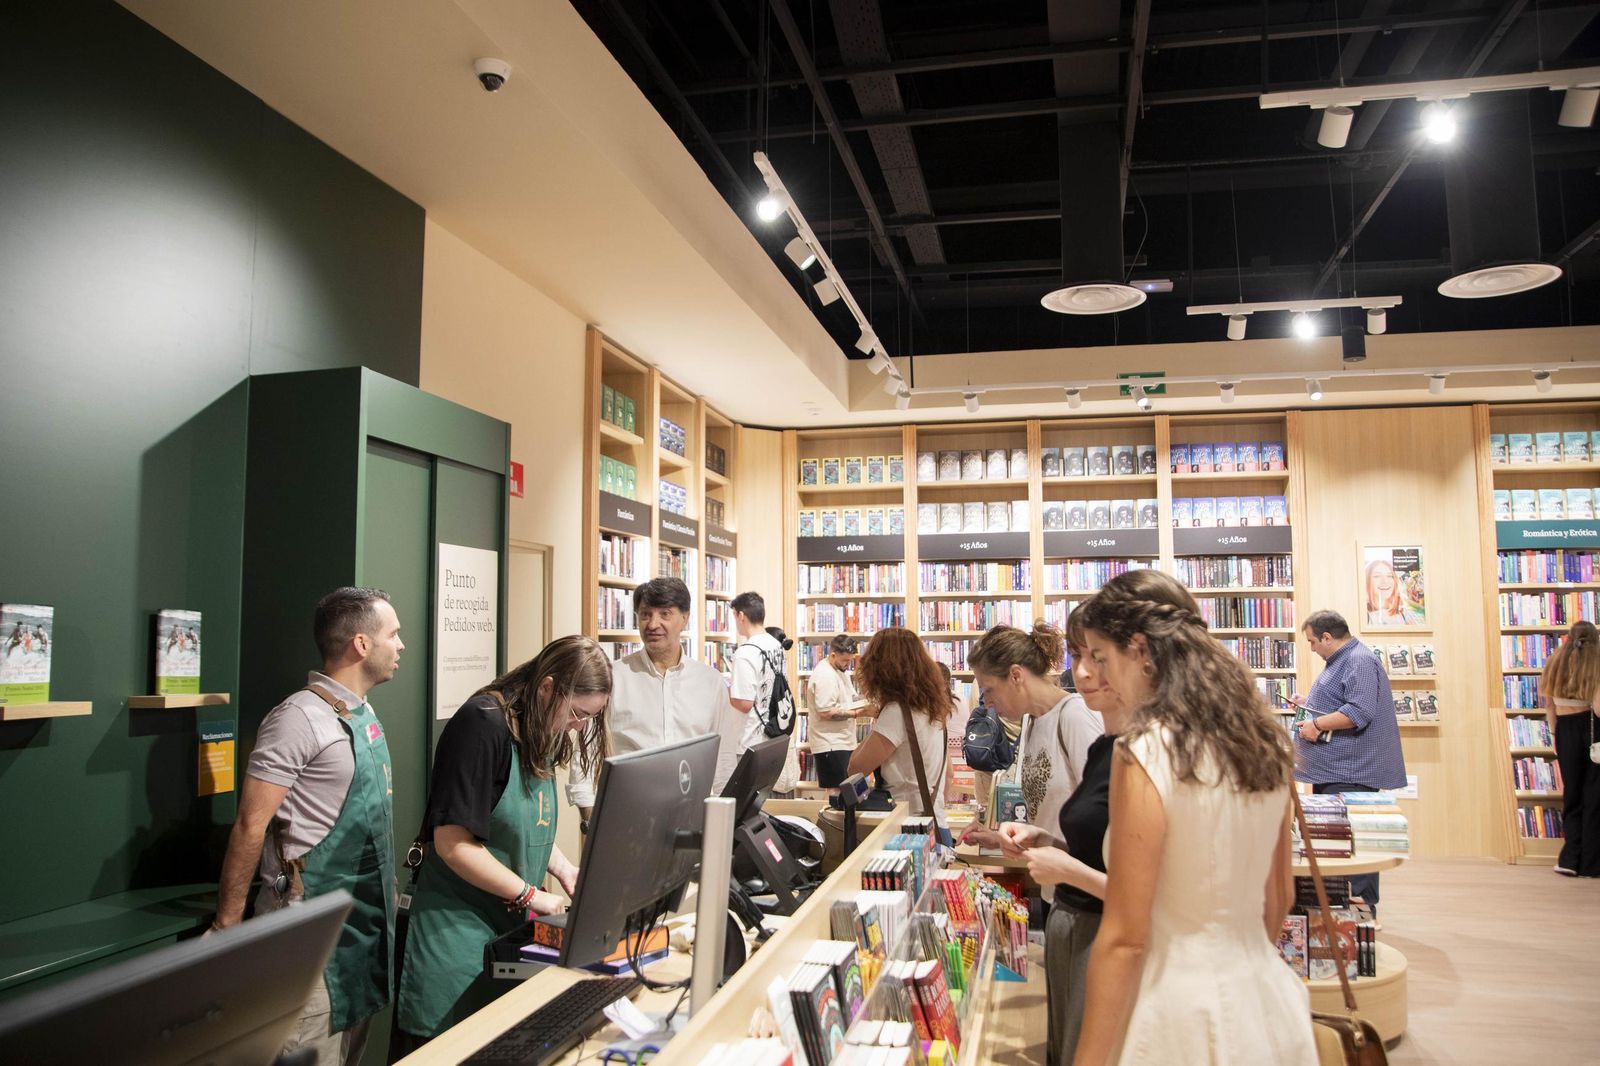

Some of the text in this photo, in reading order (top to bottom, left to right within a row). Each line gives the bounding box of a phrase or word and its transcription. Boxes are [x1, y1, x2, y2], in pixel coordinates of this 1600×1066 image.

[1523, 529, 1563, 538] Romántica
[1570, 528, 1597, 537] Erótica
[971, 541, 988, 549] Años
[1229, 536, 1247, 544] Años
[848, 544, 864, 552] Años
[445, 568, 476, 589] Punto
[444, 595, 488, 615] de recogida
[444, 618, 494, 632] Pedidos web.
